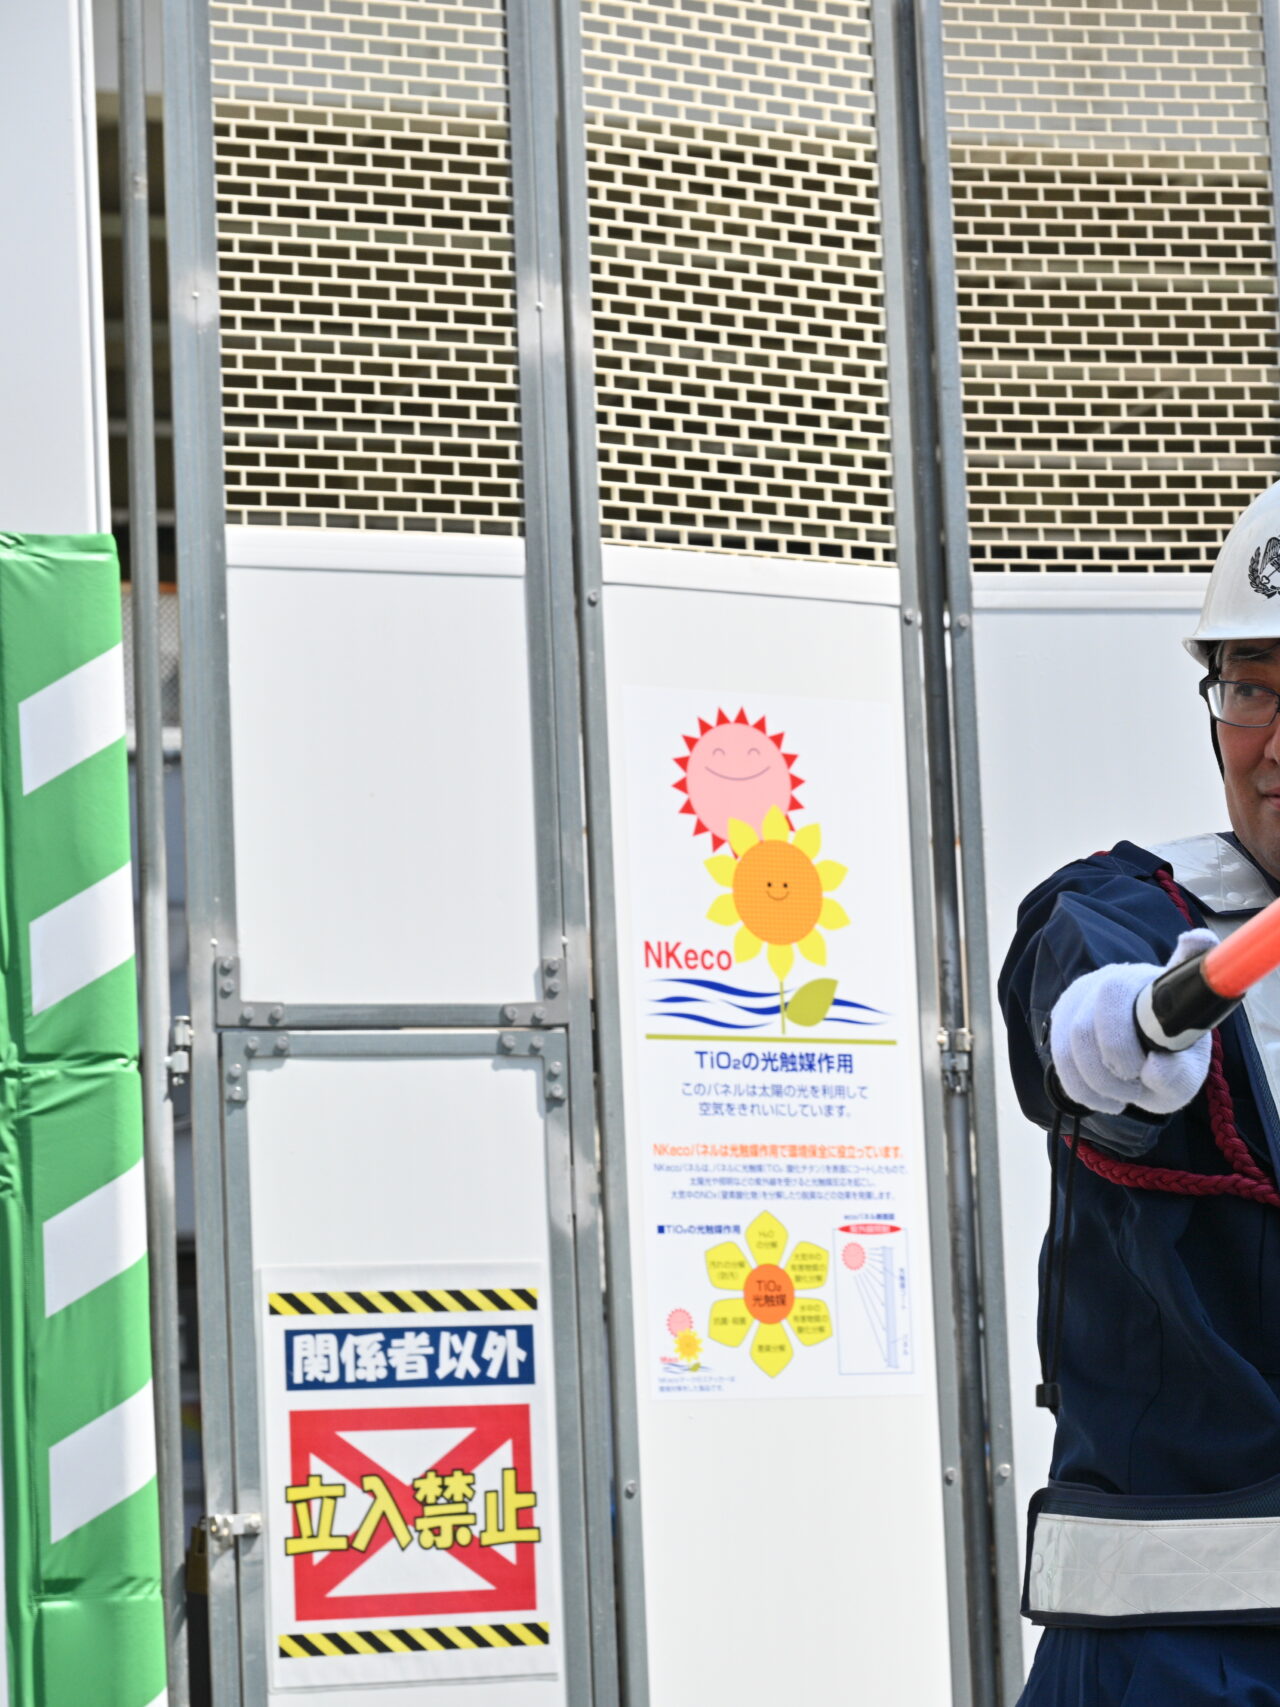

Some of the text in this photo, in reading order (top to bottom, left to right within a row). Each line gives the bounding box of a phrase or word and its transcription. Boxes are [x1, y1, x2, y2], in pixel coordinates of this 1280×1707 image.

[644, 940, 733, 971] NKeco
[681, 1082, 869, 1100] このパネルは太陽の光を利用して
[698, 1102, 851, 1117] 空気をきれいにしています。
[752, 1293, 787, 1308] 光触媒
[291, 1326, 529, 1385] 関係者以外
[284, 1466, 542, 1557] 立入禁止
